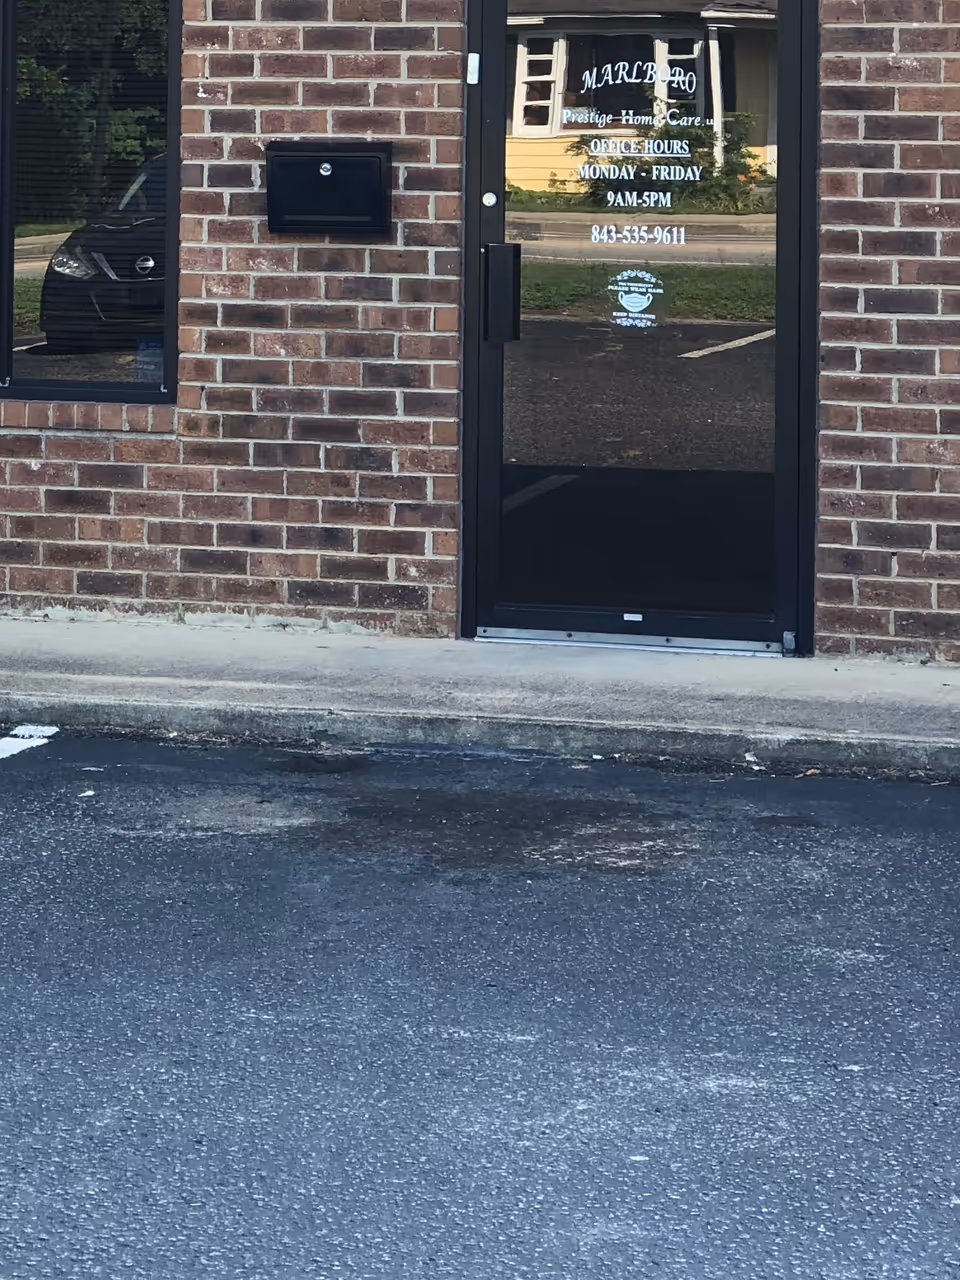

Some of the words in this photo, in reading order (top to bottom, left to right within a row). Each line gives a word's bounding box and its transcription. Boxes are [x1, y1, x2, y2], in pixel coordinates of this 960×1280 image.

[580, 61, 697, 94] MARLBORO
[561, 109, 613, 128] Prestige
[621, 110, 660, 125] Home
[590, 139, 639, 154] OFFICE
[644, 140, 690, 154] HOURS
[577, 165, 637, 180] MONDAY
[652, 166, 702, 180] FRIDAY
[607, 191, 672, 207] 9AM-5PM
[591, 225, 686, 245] 843-535-9611
